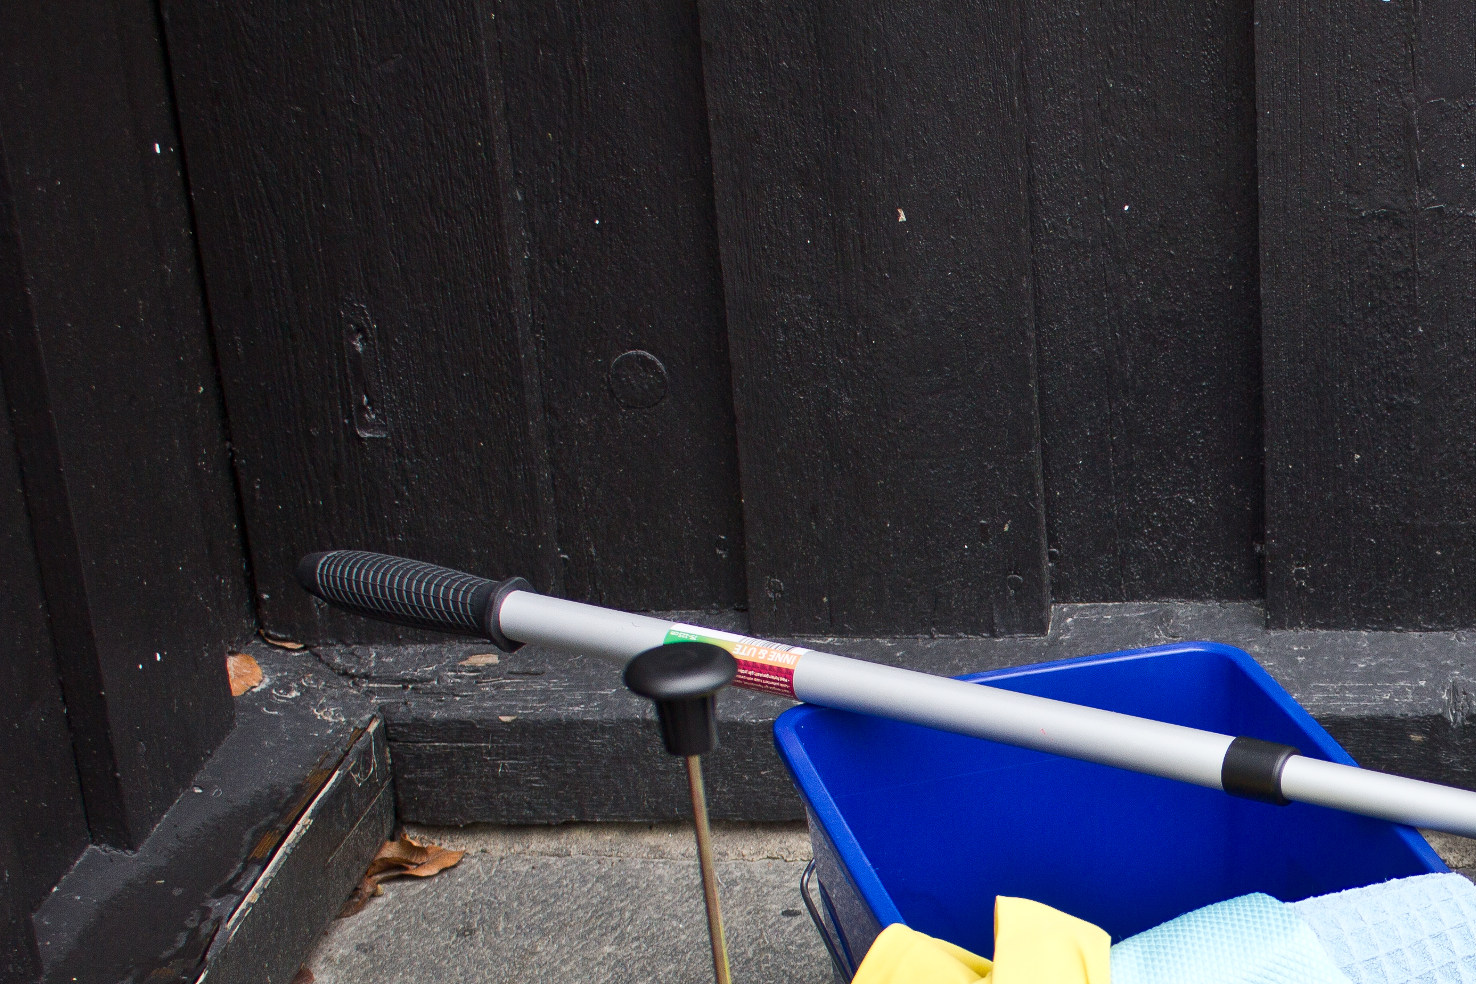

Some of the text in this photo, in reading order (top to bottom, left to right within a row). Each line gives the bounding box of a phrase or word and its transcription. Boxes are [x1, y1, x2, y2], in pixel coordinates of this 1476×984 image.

[732, 644, 797, 665] INNE & UTE
